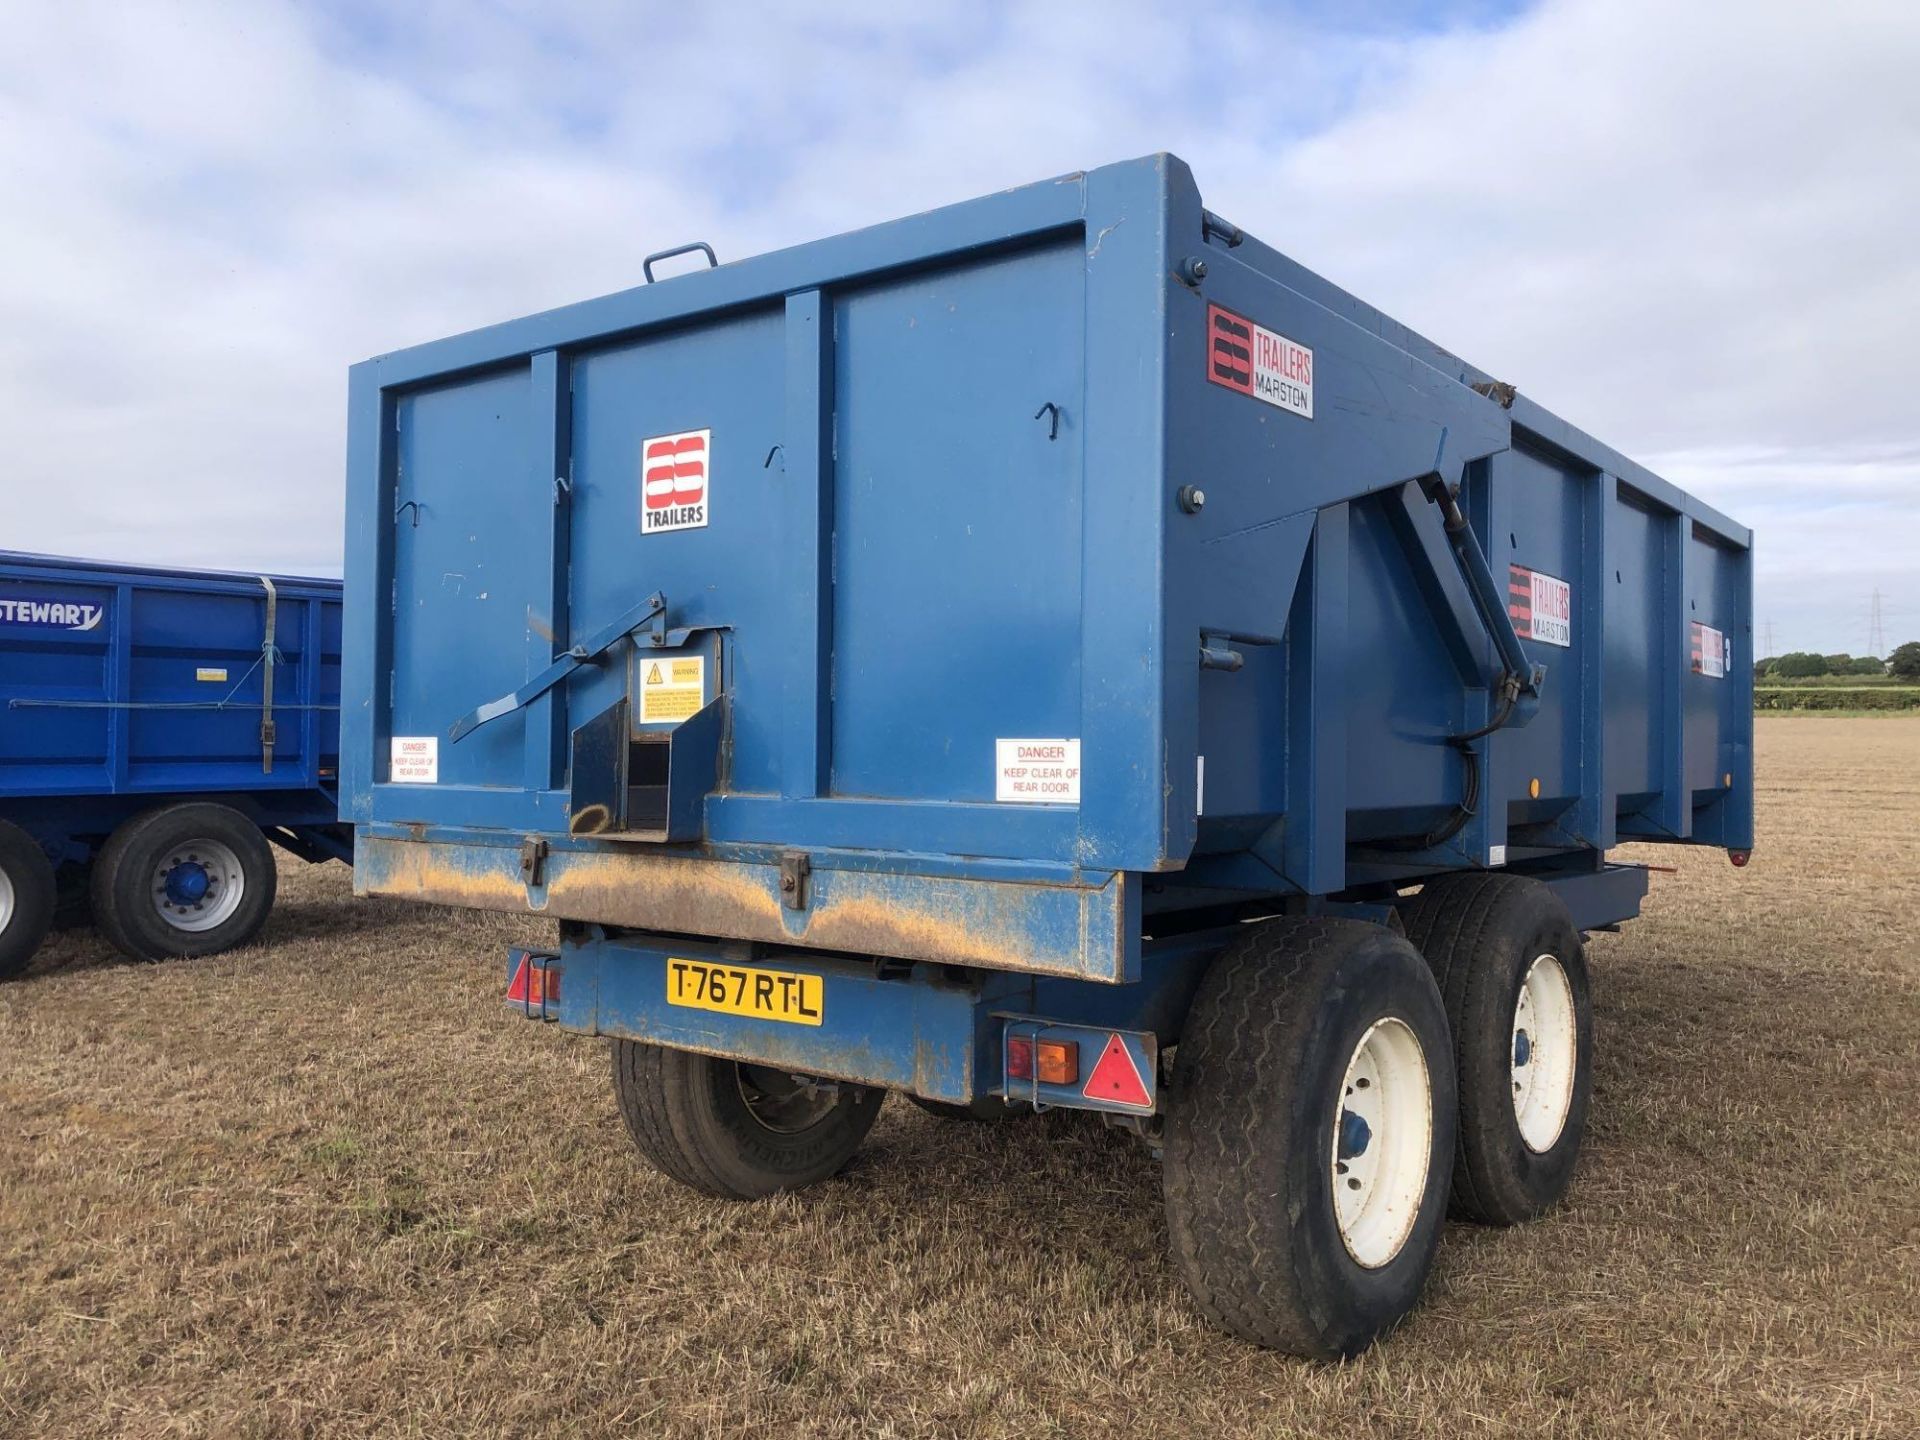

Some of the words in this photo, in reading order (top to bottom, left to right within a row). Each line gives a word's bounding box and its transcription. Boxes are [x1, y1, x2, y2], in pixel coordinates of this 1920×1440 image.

[1256, 332, 1311, 386] TRAILERS
[1255, 372, 1308, 410] MARSTON
[646, 506, 703, 528] TRAILERS
[1533, 577, 1568, 621] TRAILERS
[0, 600, 102, 630] TEWART
[1533, 618, 1568, 642] MARSTON
[1018, 747, 1065, 758] DANGER
[1004, 768, 1028, 778] KEEP
[1031, 768, 1063, 779] CLEAR
[1066, 768, 1079, 779] OF
[1013, 782, 1038, 792] REAR
[1041, 783, 1069, 793] DOOR
[672, 963, 748, 1007] T767
[755, 974, 818, 1018] RTL
